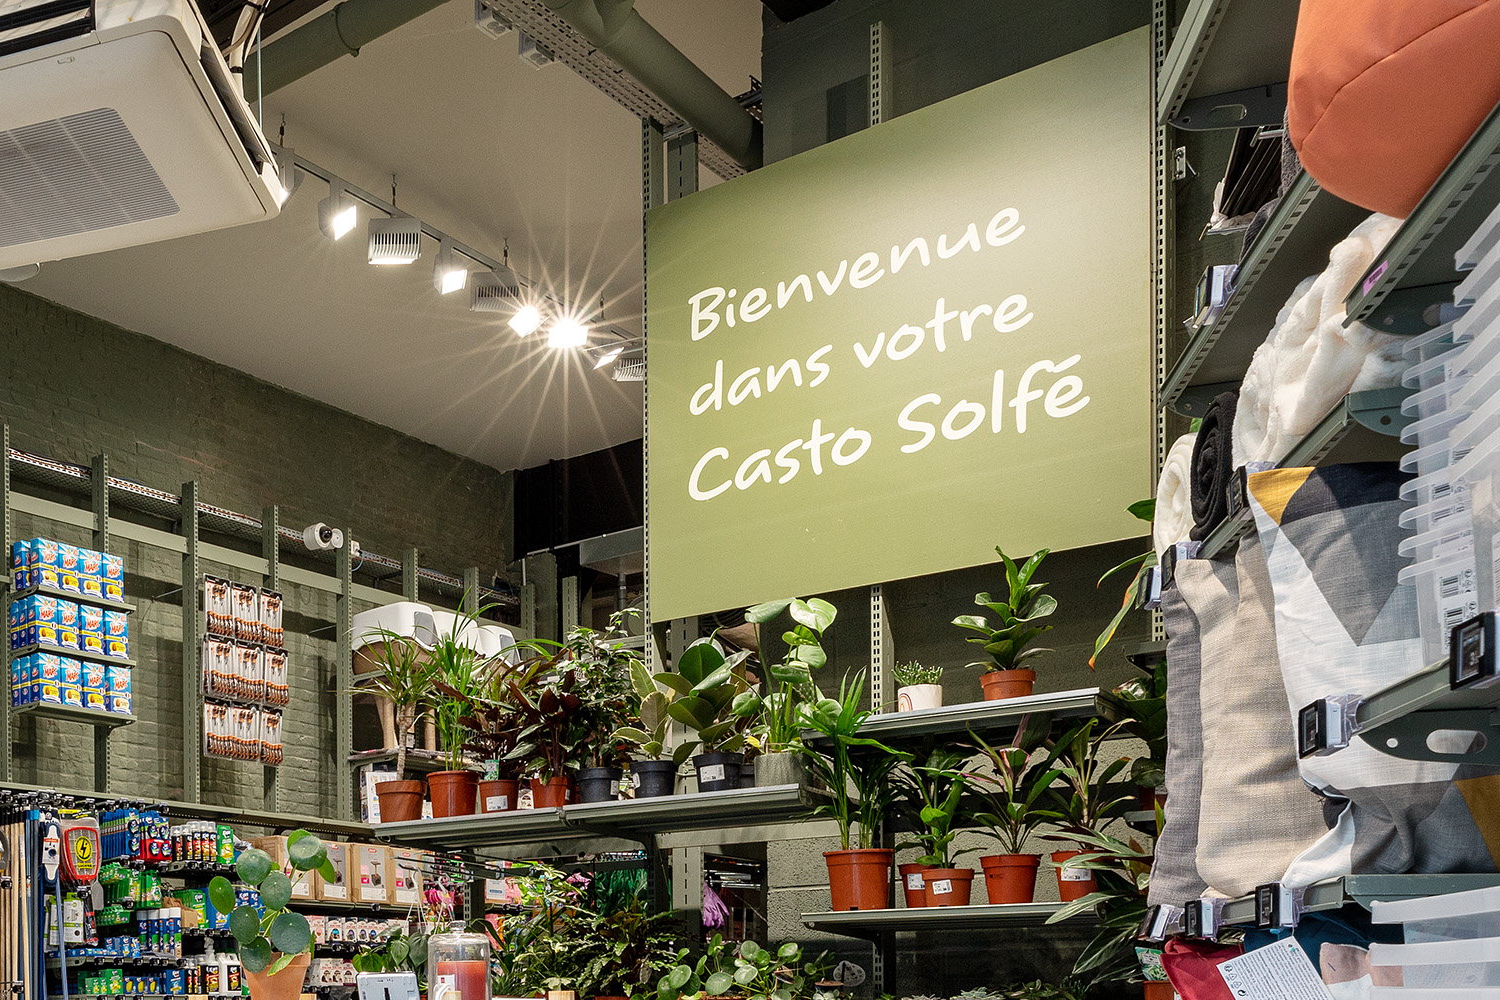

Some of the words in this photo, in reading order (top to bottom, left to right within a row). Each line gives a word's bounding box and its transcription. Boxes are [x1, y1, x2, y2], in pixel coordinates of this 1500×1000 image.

[687, 206, 1026, 341] Bienvenue
[689, 344, 833, 416] dans
[853, 293, 1034, 368] votre
[687, 418, 872, 502] Casto
[897, 353, 1092, 455] Solfé
